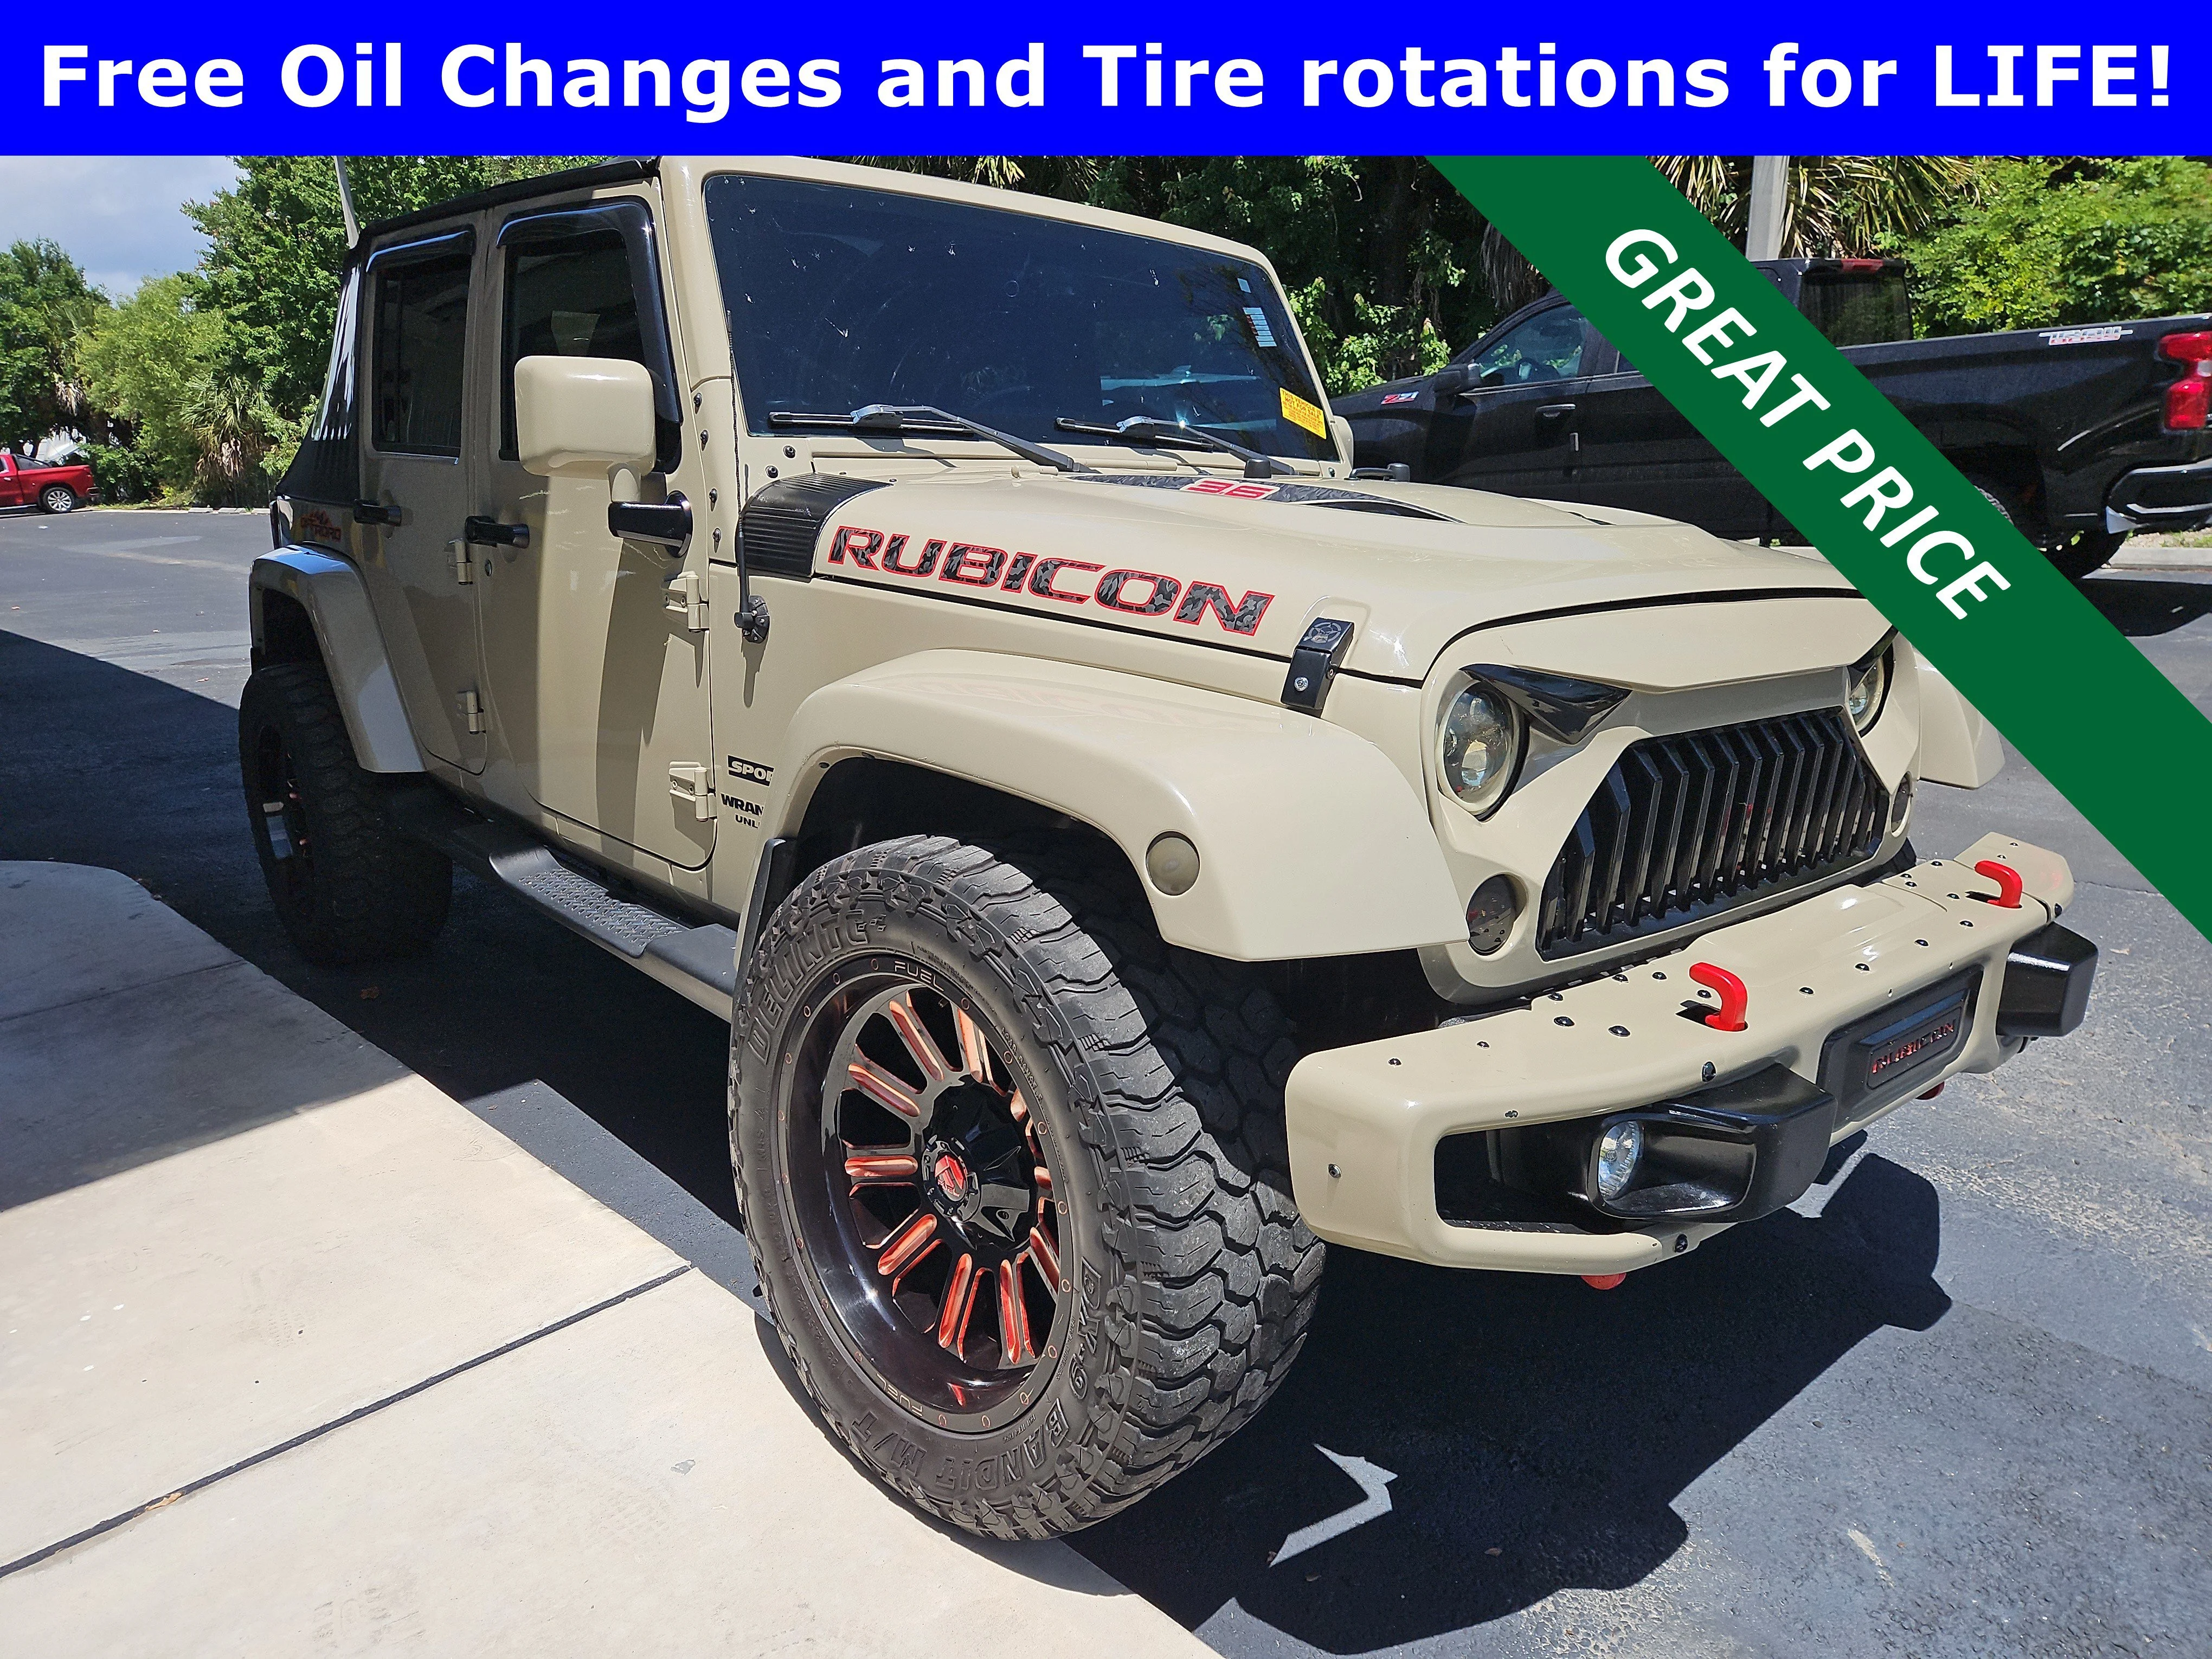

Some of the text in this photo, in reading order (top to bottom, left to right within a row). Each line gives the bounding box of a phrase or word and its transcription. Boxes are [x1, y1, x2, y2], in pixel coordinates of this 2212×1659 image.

[1281, 390, 1294, 400] THIS
[1294, 396, 1315, 413] VEHICLE
[1296, 403, 1307, 411] FOR
[1307, 409, 1320, 421] SALE
[1380, 391, 1419, 404] Z71
[827, 525, 1275, 636] RUBICON
[894, 960, 945, 992] FUEL
[877, 1373, 923, 1417] FUEL
[850, 1397, 1070, 1490] BANDIT M/T
